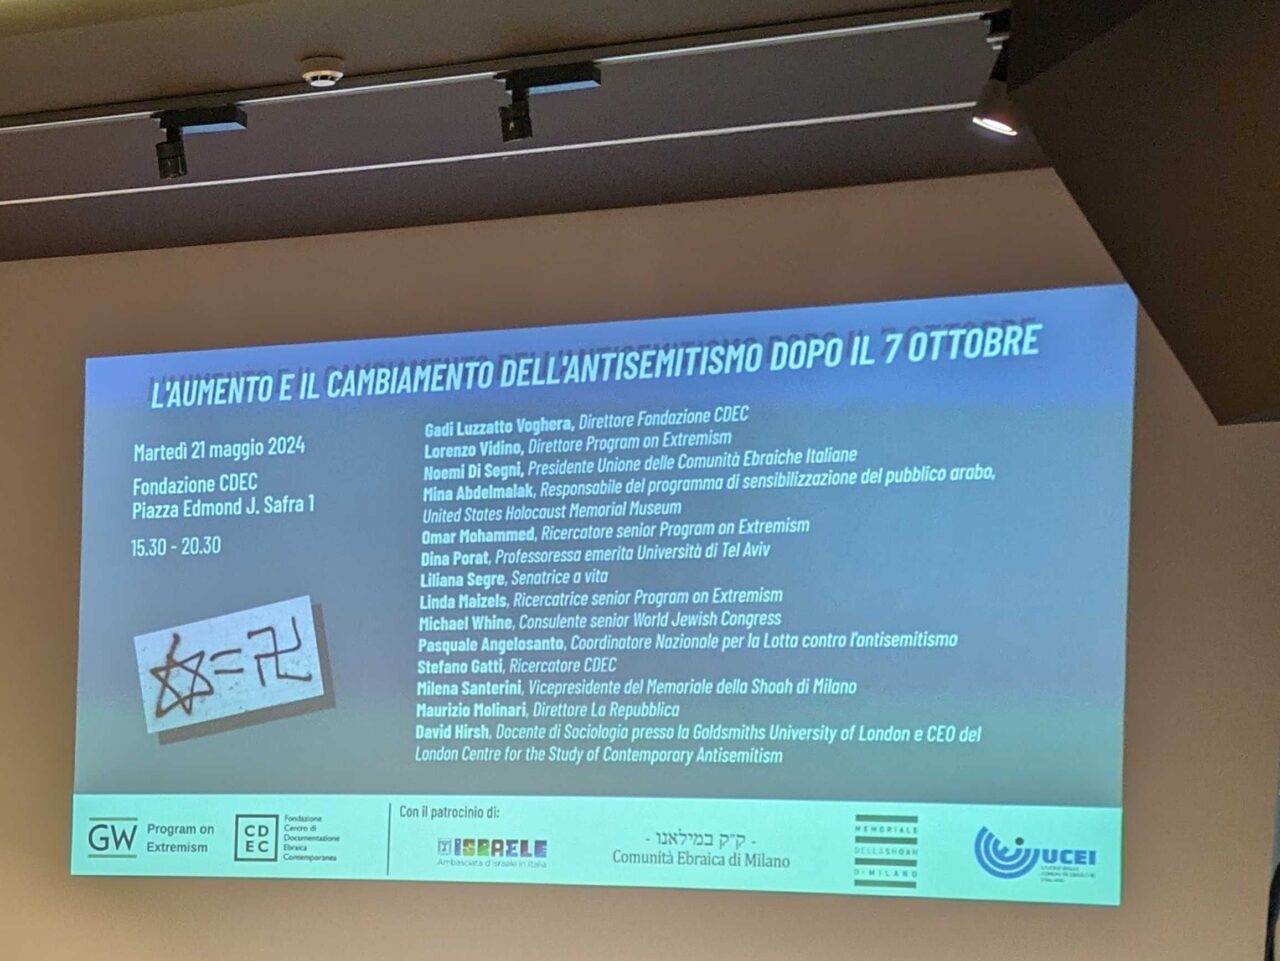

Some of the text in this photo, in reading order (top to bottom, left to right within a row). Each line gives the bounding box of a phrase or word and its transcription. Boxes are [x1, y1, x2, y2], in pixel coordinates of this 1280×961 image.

[151, 323, 1043, 408] L'AUMENTO E IL CAMBIAMENTO DELL'ANTISEMITISMO DOPO IL 7 OTTOBRE
[424, 404, 750, 438] Gadi Luzzatto Voghera, Direttore Fondazione CDEC
[134, 434, 305, 462] Martedì 21 maggio 2024
[424, 429, 732, 459] Lorenzo Vidino, Direttore Program on Extremism
[133, 472, 258, 496] Fondazione CDEC
[422, 463, 995, 502] Mina Abdelmalak, Responsabile del programma di sensibilizzazione del pubblico arabo,
[132, 493, 314, 519] Piazza Edmond J. Safra 1
[422, 500, 682, 524] United States Holocaust Memorial Museum
[421, 516, 810, 545] Omar Mohammed, Ricercatore senior Program on Extremism
[131, 537, 166, 557] 15.30
[181, 535, 221, 555] 20.30
[420, 568, 608, 591] Liliana Segre, Senatrice a vita
[418, 630, 958, 656] Pasquale Angelosanto, Coordinatore Nazionale per la Lotta contro l'antisemitismo
[417, 656, 617, 676] Stefano Gatti, Ricercatore CDEC
[416, 701, 680, 721] Maurizio Molinari, Direttore La Repubblica
[415, 723, 982, 744] David Hirsh, Docente di Sociologia presso la Goldsmiths University of London e CEO del
[415, 745, 783, 766] London Centre for the Study of Contemporary Antisemitism
[284, 814, 322, 823] Fondazione
[399, 805, 500, 820] Con il patrocinio di:
[88, 824, 137, 851] GW
[147, 824, 214, 836] Program on
[283, 834, 340, 842] Documentazione
[284, 824, 308, 832] Centro
[147, 841, 208, 853] Extremism
[283, 843, 307, 852] Ebraica
[283, 853, 337, 862] Contemporanea
[1042, 849, 1096, 866] UCEI
[612, 849, 791, 869] Comunità Ebraica di Milano
